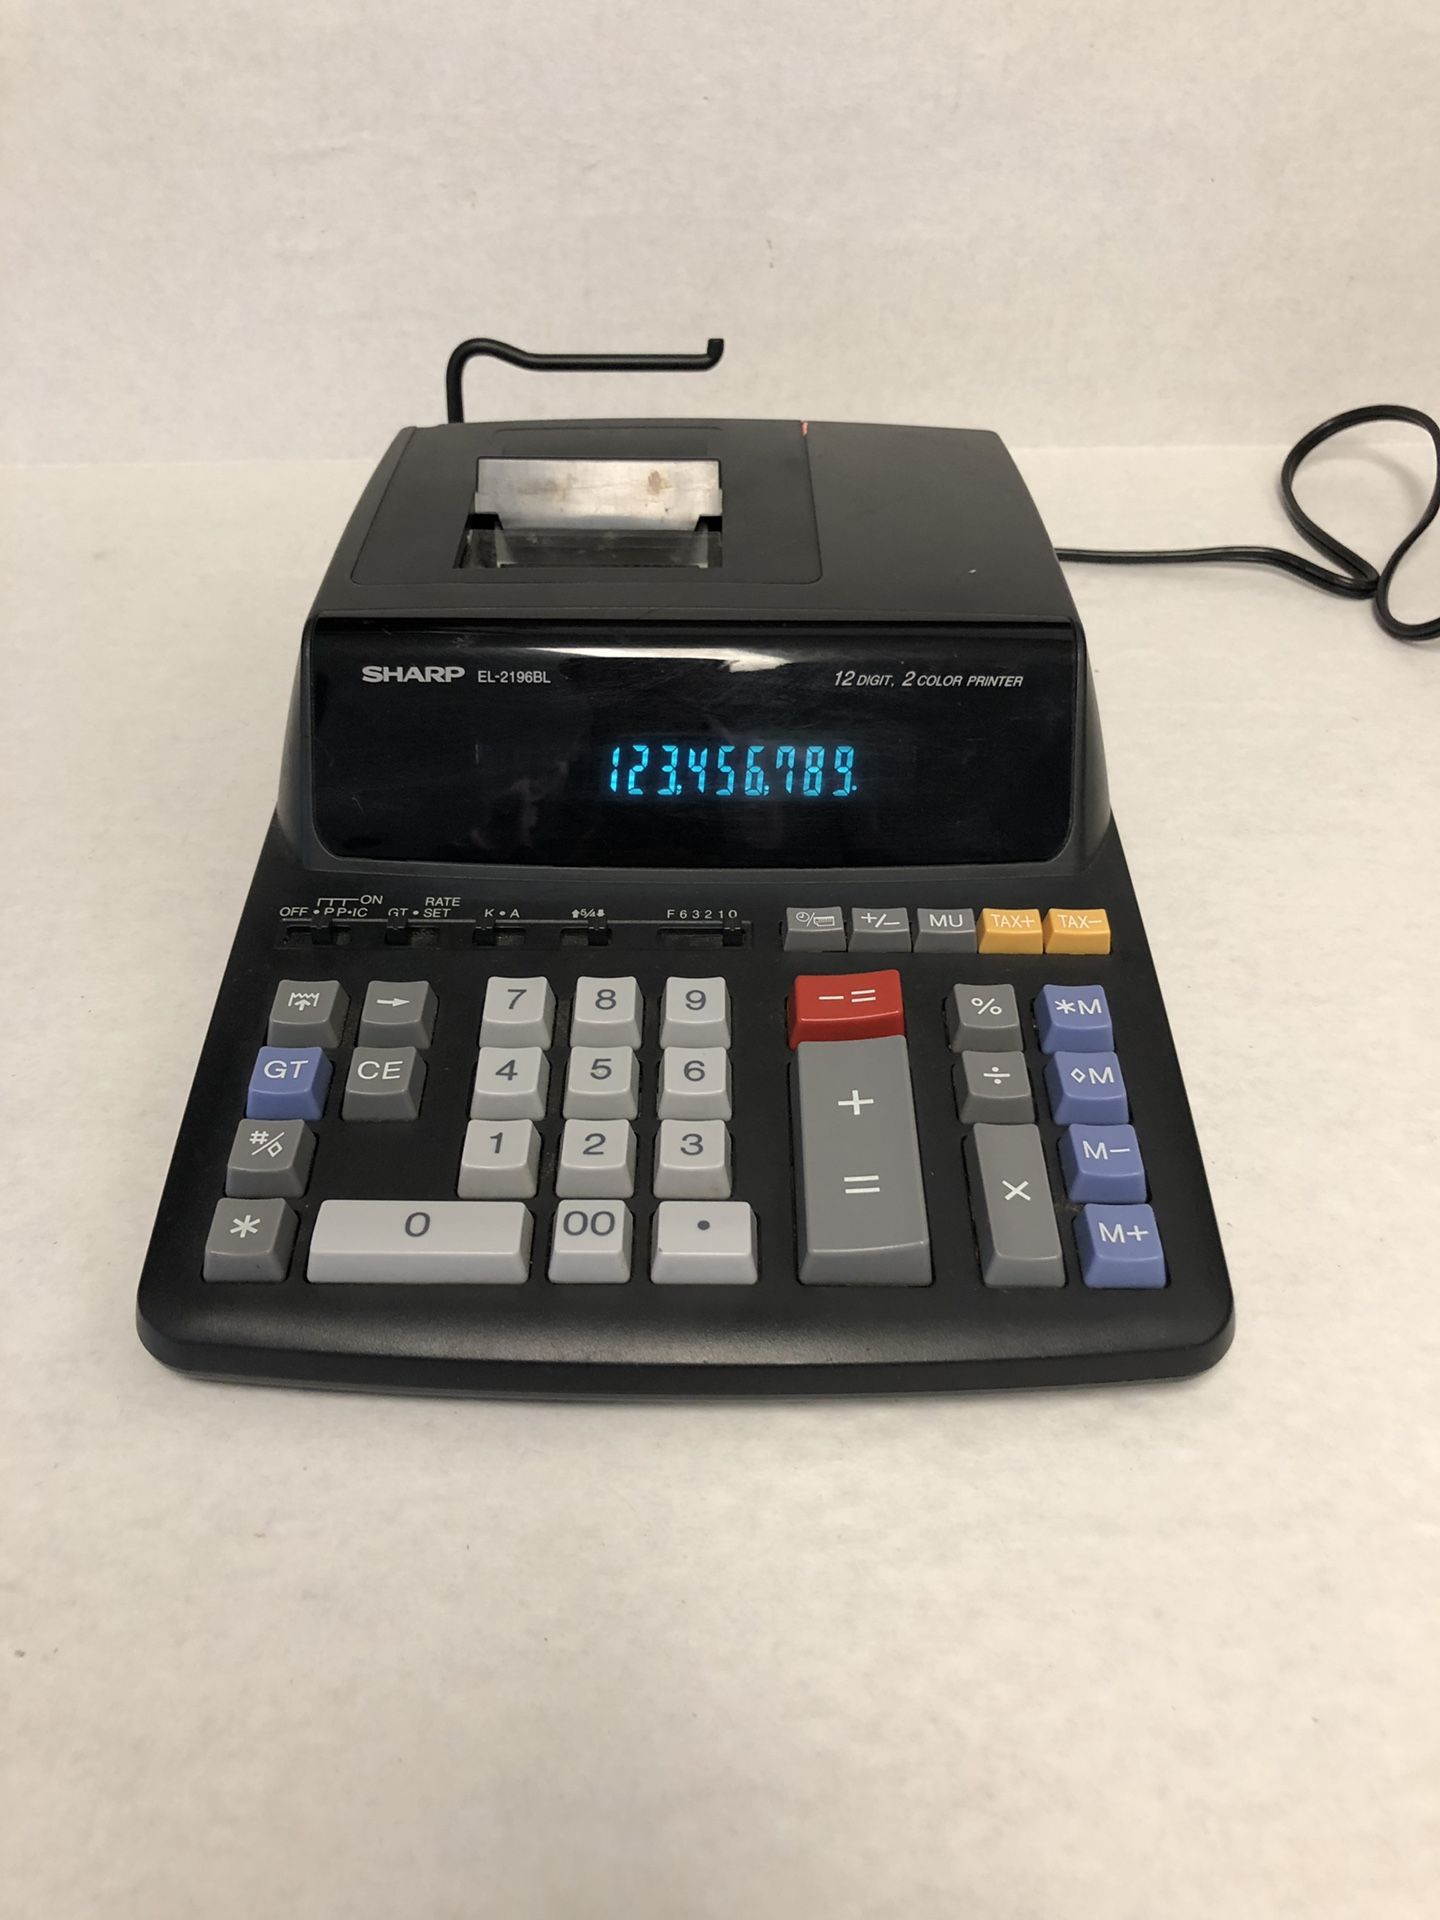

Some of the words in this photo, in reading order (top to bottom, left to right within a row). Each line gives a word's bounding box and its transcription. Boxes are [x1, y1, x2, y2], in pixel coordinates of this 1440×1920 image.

[361, 665, 466, 683] SHARP
[477, 670, 551, 684] EL-2196BL
[834, 670, 856, 687] 12
[856, 674, 895, 688] DIGIT,
[901, 670, 917, 687] 2
[917, 674, 963, 688] COLOR
[966, 675, 1024, 688] PRINTER
[360, 894, 384, 905] ON
[425, 896, 461, 907] RATE
[279, 906, 309, 918] OFF
[423, 907, 451, 918] SET
[929, 914, 963, 928] MU
[990, 913, 1035, 928] TAX+
[507, 988, 528, 1010] 7
[594, 988, 617, 1010] 8
[685, 989, 707, 1011] 9
[971, 997, 1003, 1015] %
[263, 1060, 309, 1080] GT
[357, 1060, 404, 1080] CE
[495, 1059, 518, 1081] 4
[590, 1058, 612, 1080] 5
[683, 1060, 706, 1082] 6
[489, 1131, 504, 1154] 1
[582, 1132, 607, 1156] 2
[680, 1133, 704, 1156] 3
[404, 1211, 431, 1238] 0
[563, 1210, 616, 1237] 00
[1098, 1222, 1149, 1244] M+
